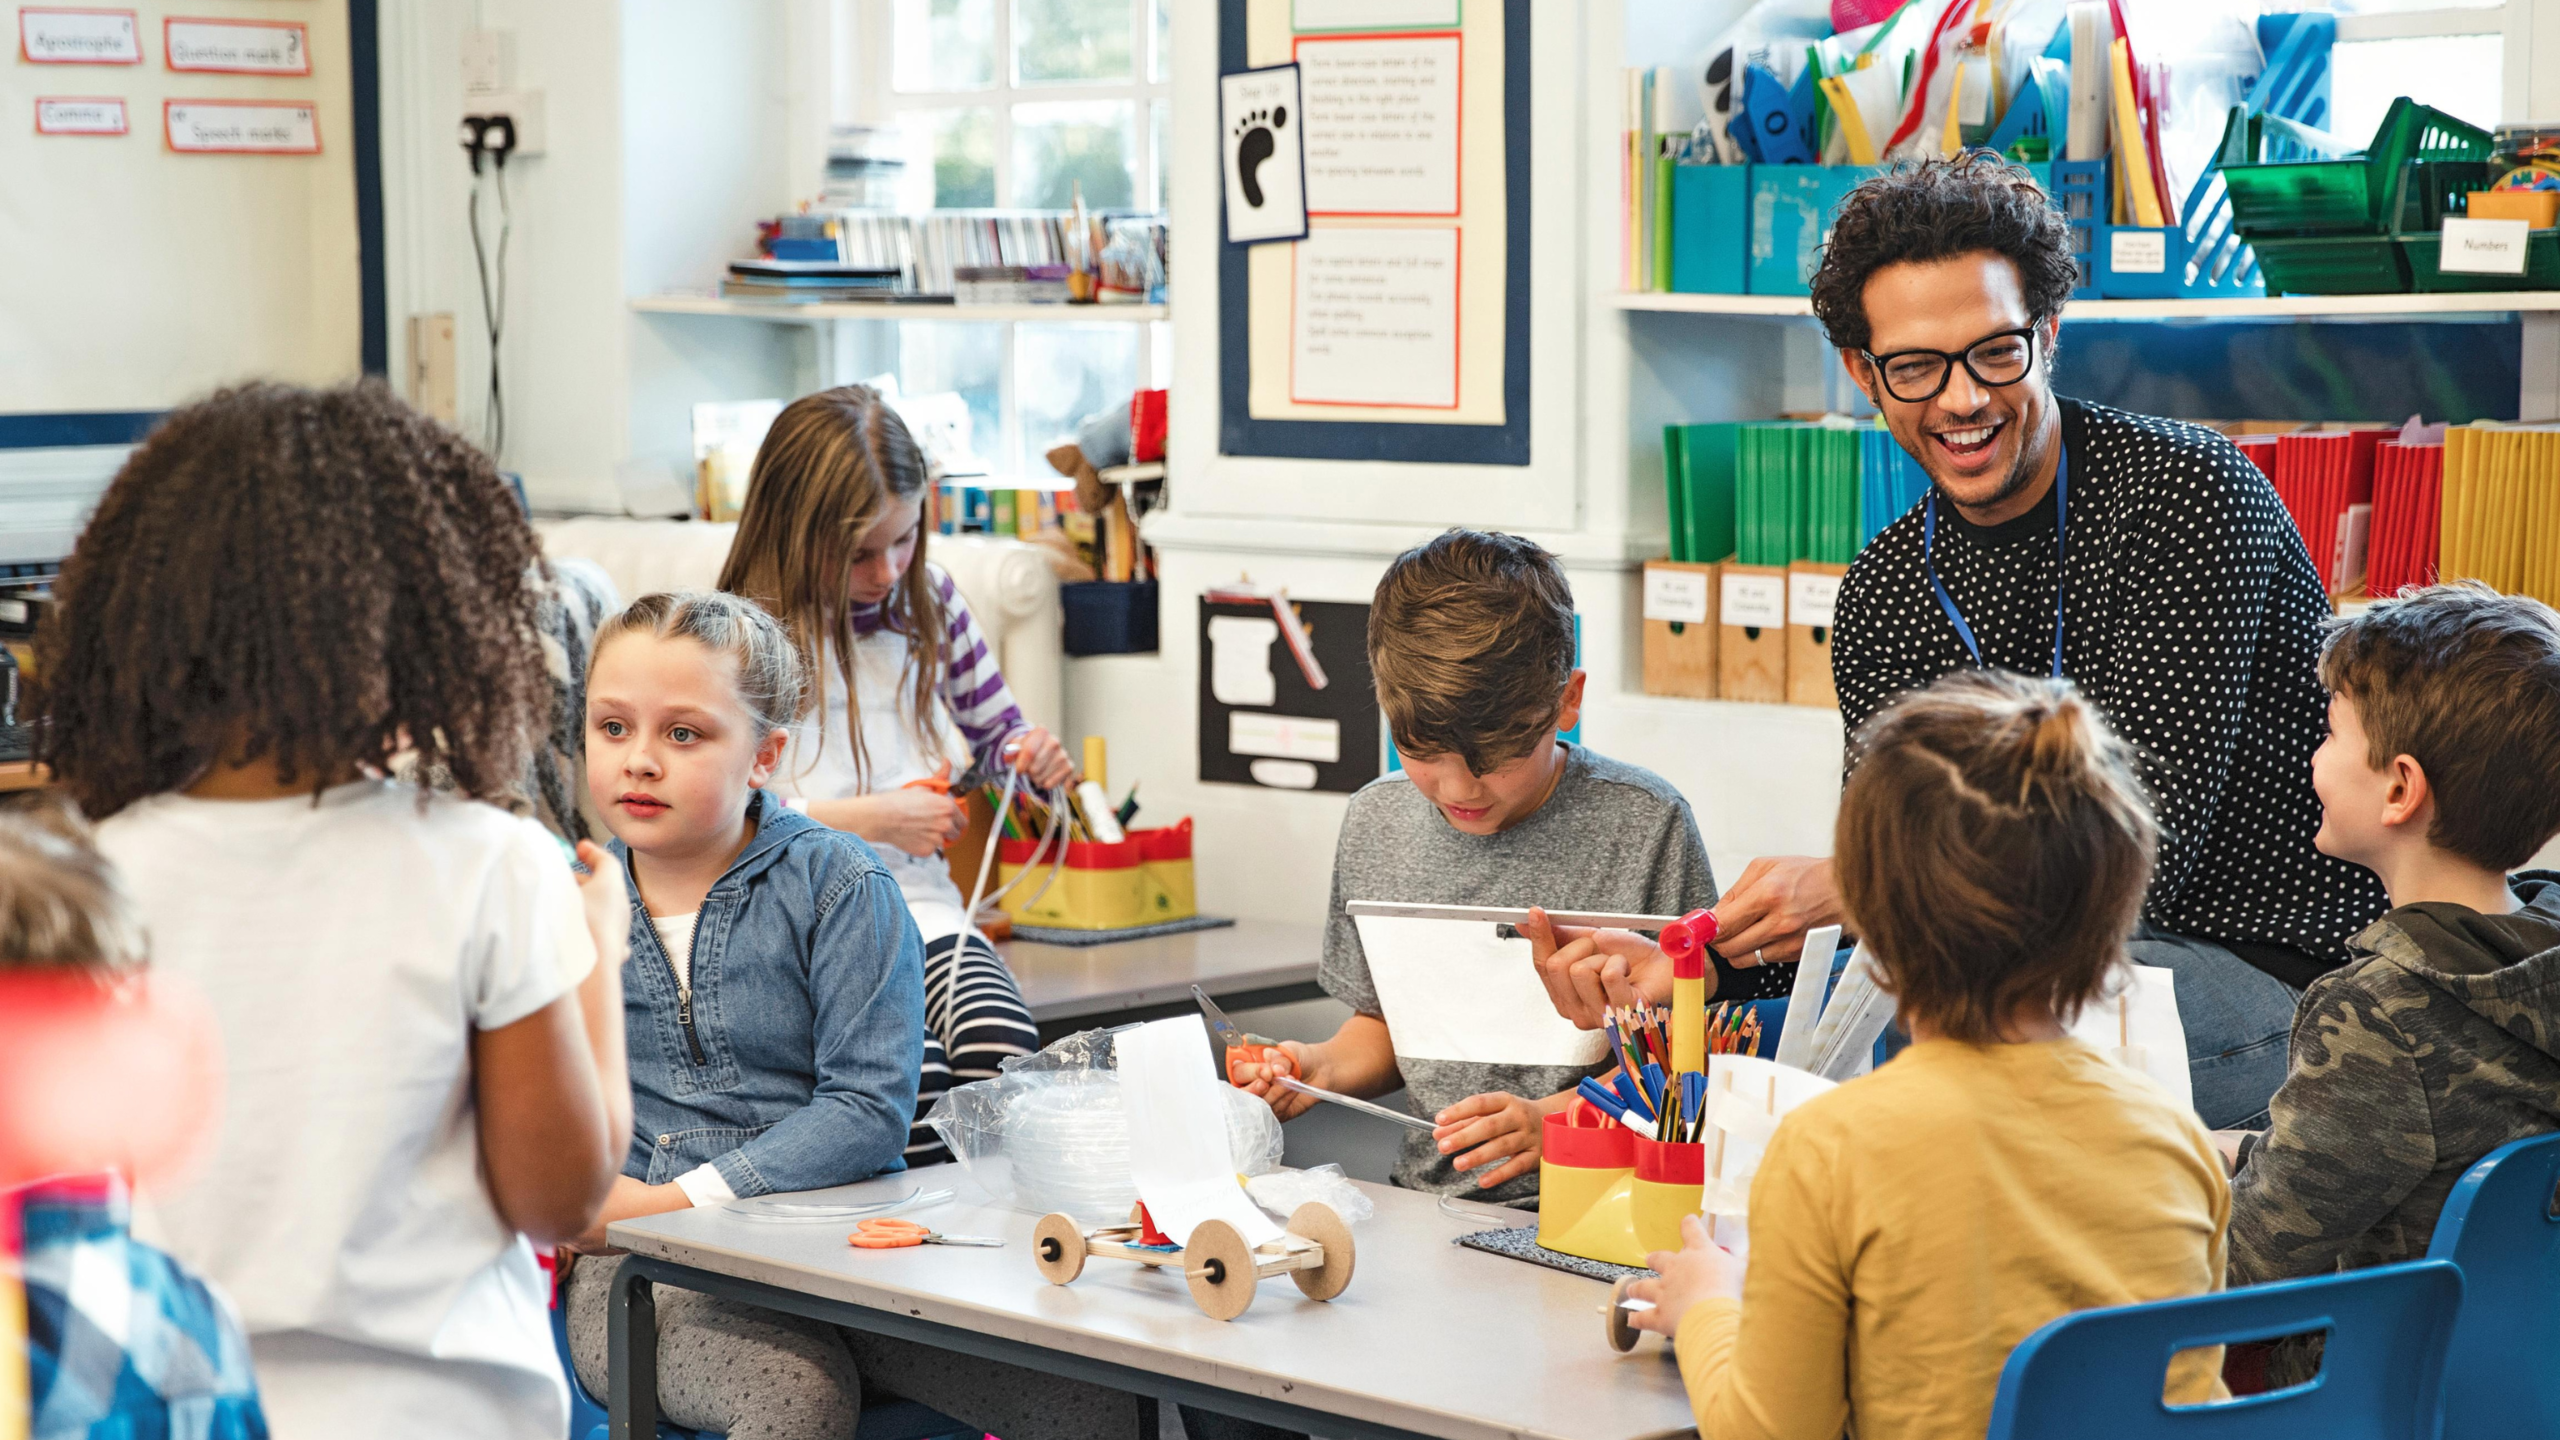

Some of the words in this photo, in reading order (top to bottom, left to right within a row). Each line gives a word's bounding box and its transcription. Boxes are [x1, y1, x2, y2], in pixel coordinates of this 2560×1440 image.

[35, 31, 123, 55] Apostrophe
[173, 40, 237, 62] Question
[247, 46, 282, 63] mark
[44, 101, 103, 123] Comma
[192, 121, 241, 147] Speech
[249, 123, 291, 142] marks
[2464, 238, 2508, 251] Numbers
